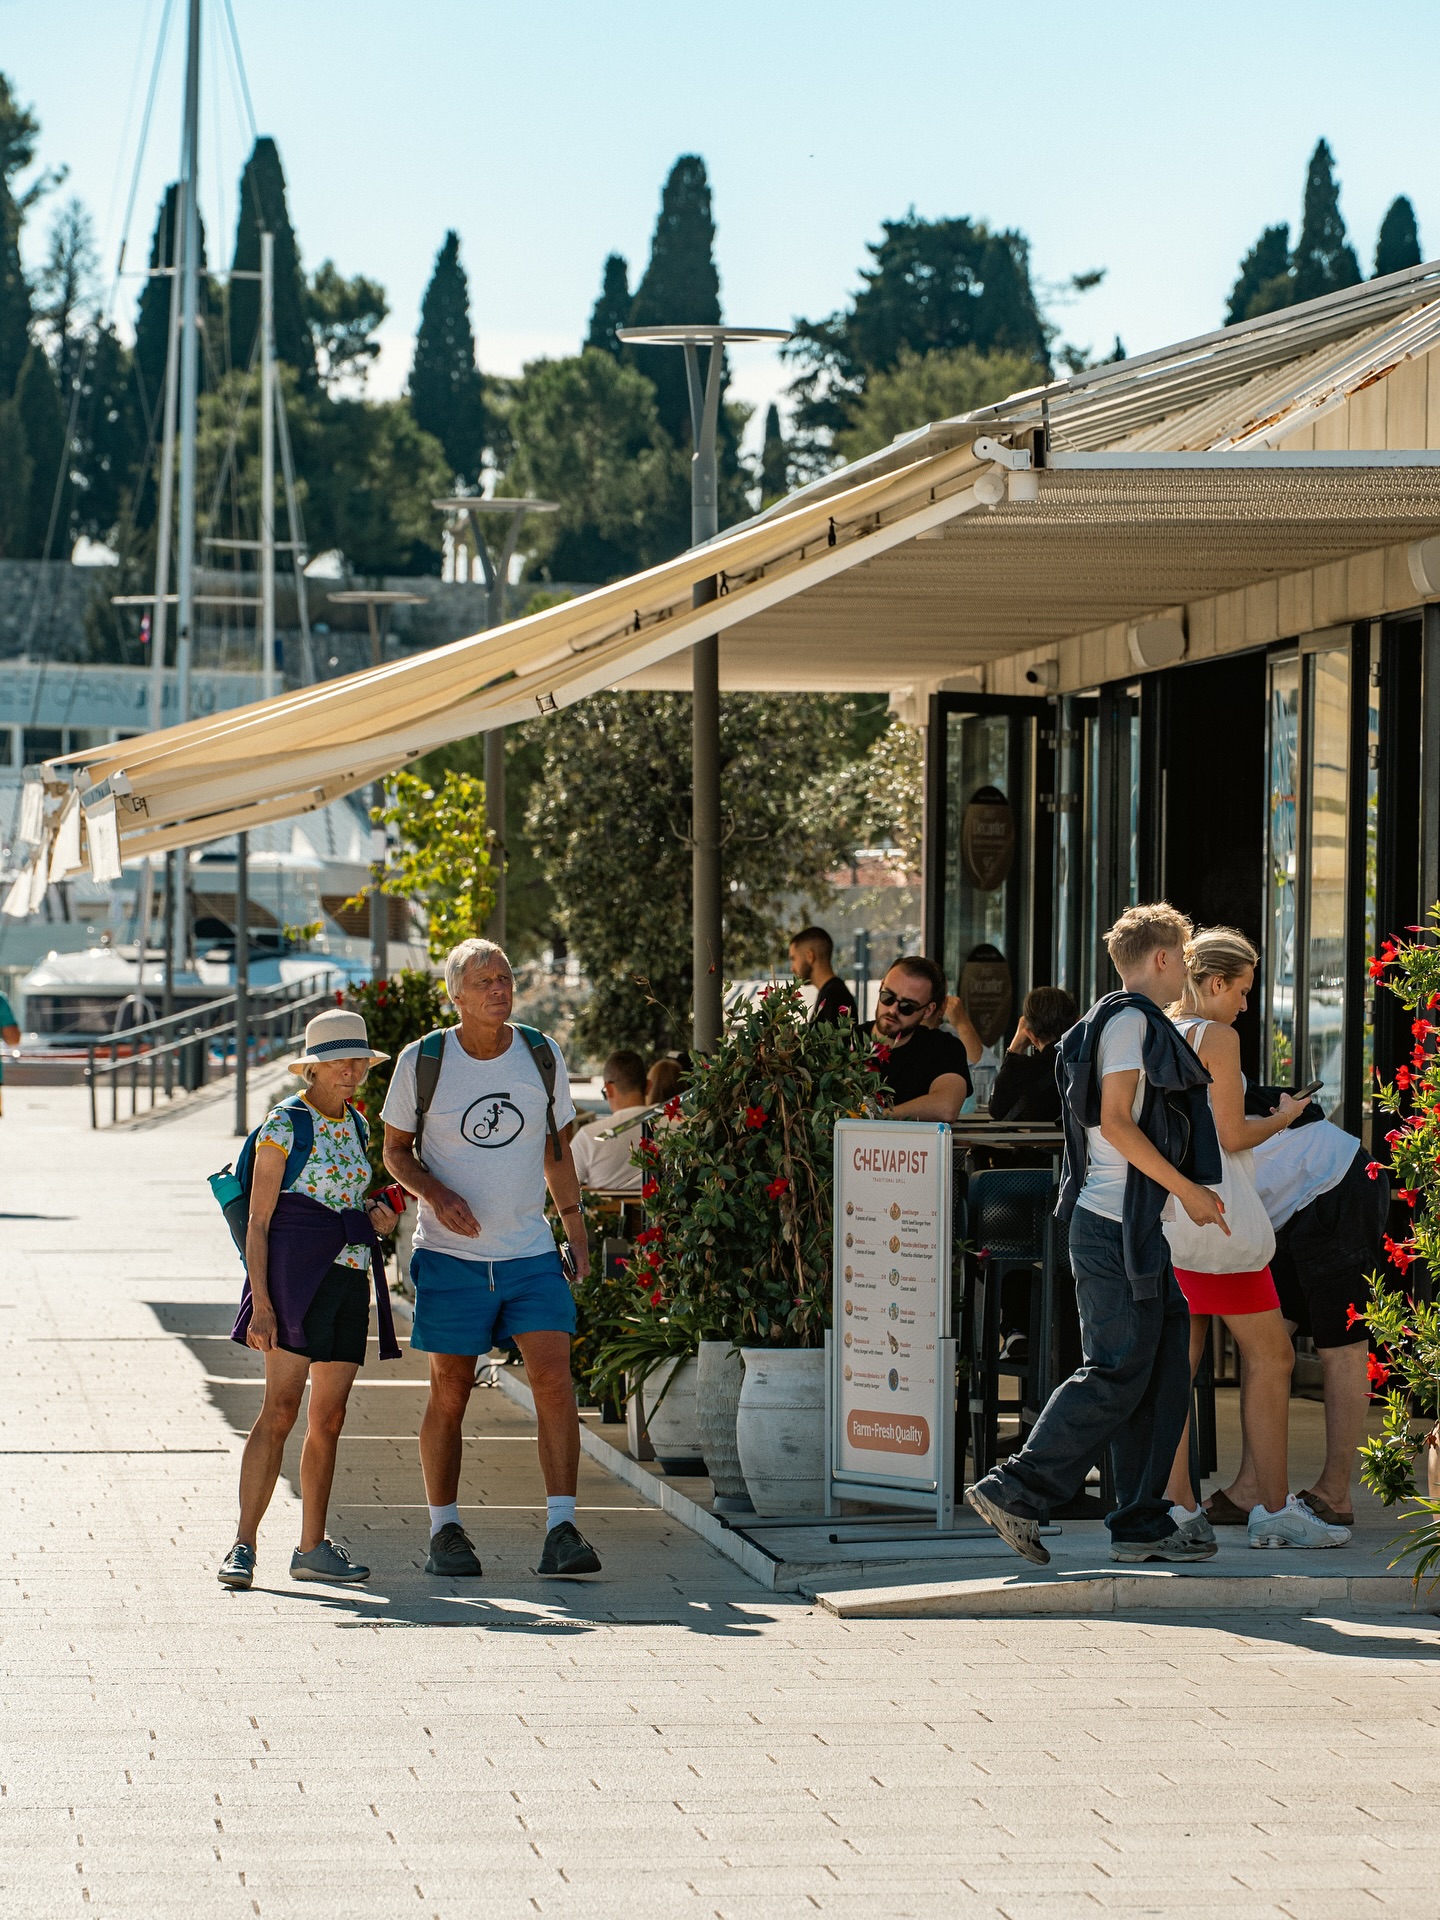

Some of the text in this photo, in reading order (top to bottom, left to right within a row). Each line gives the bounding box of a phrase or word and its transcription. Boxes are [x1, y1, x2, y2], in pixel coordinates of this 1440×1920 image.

[853, 1147, 928, 1174] CHEVAPIST
[853, 1421, 923, 1446] Farm-Fresh Quality
